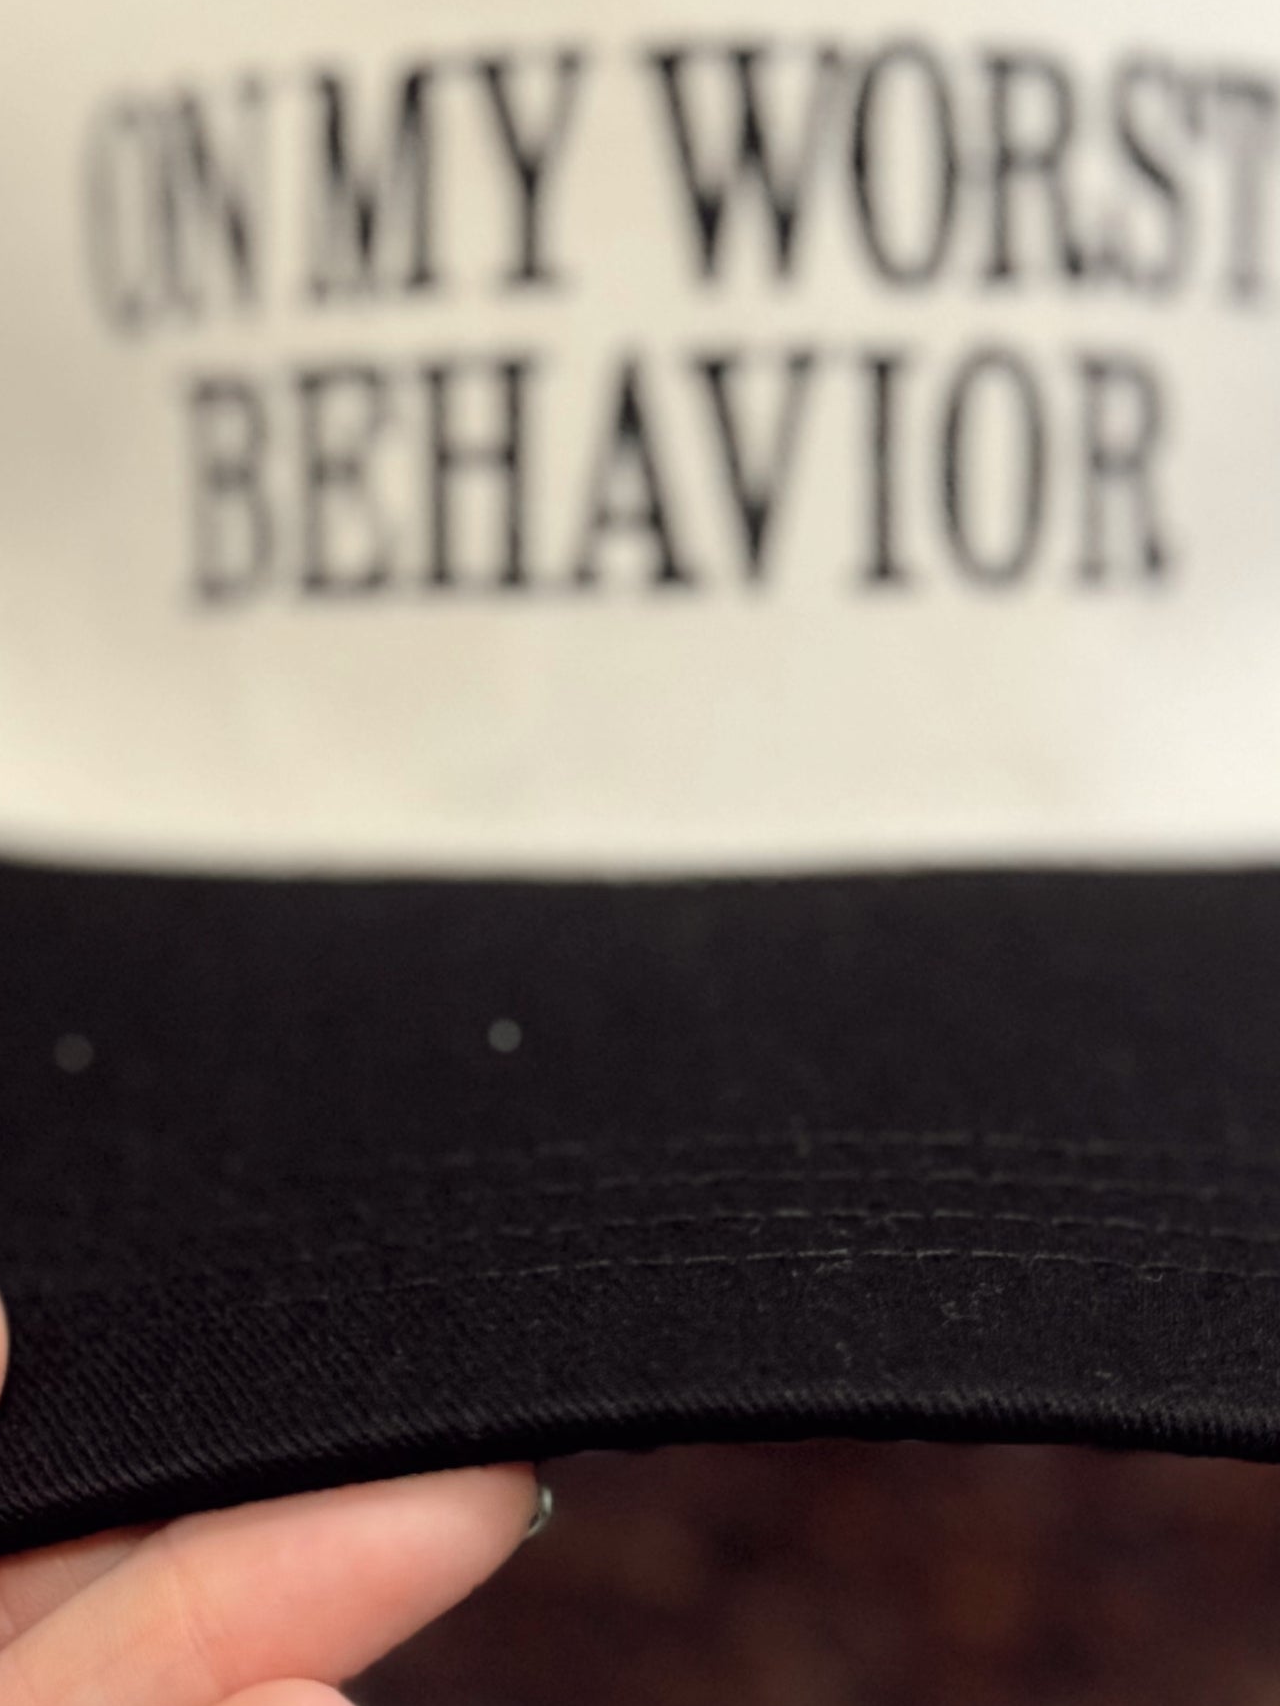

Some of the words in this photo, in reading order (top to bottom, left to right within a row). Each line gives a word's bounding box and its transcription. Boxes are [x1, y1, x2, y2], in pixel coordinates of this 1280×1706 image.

[78, 68, 270, 341] ON
[295, 41, 590, 309] MY
[180, 339, 1188, 619] BEHAVIOR
